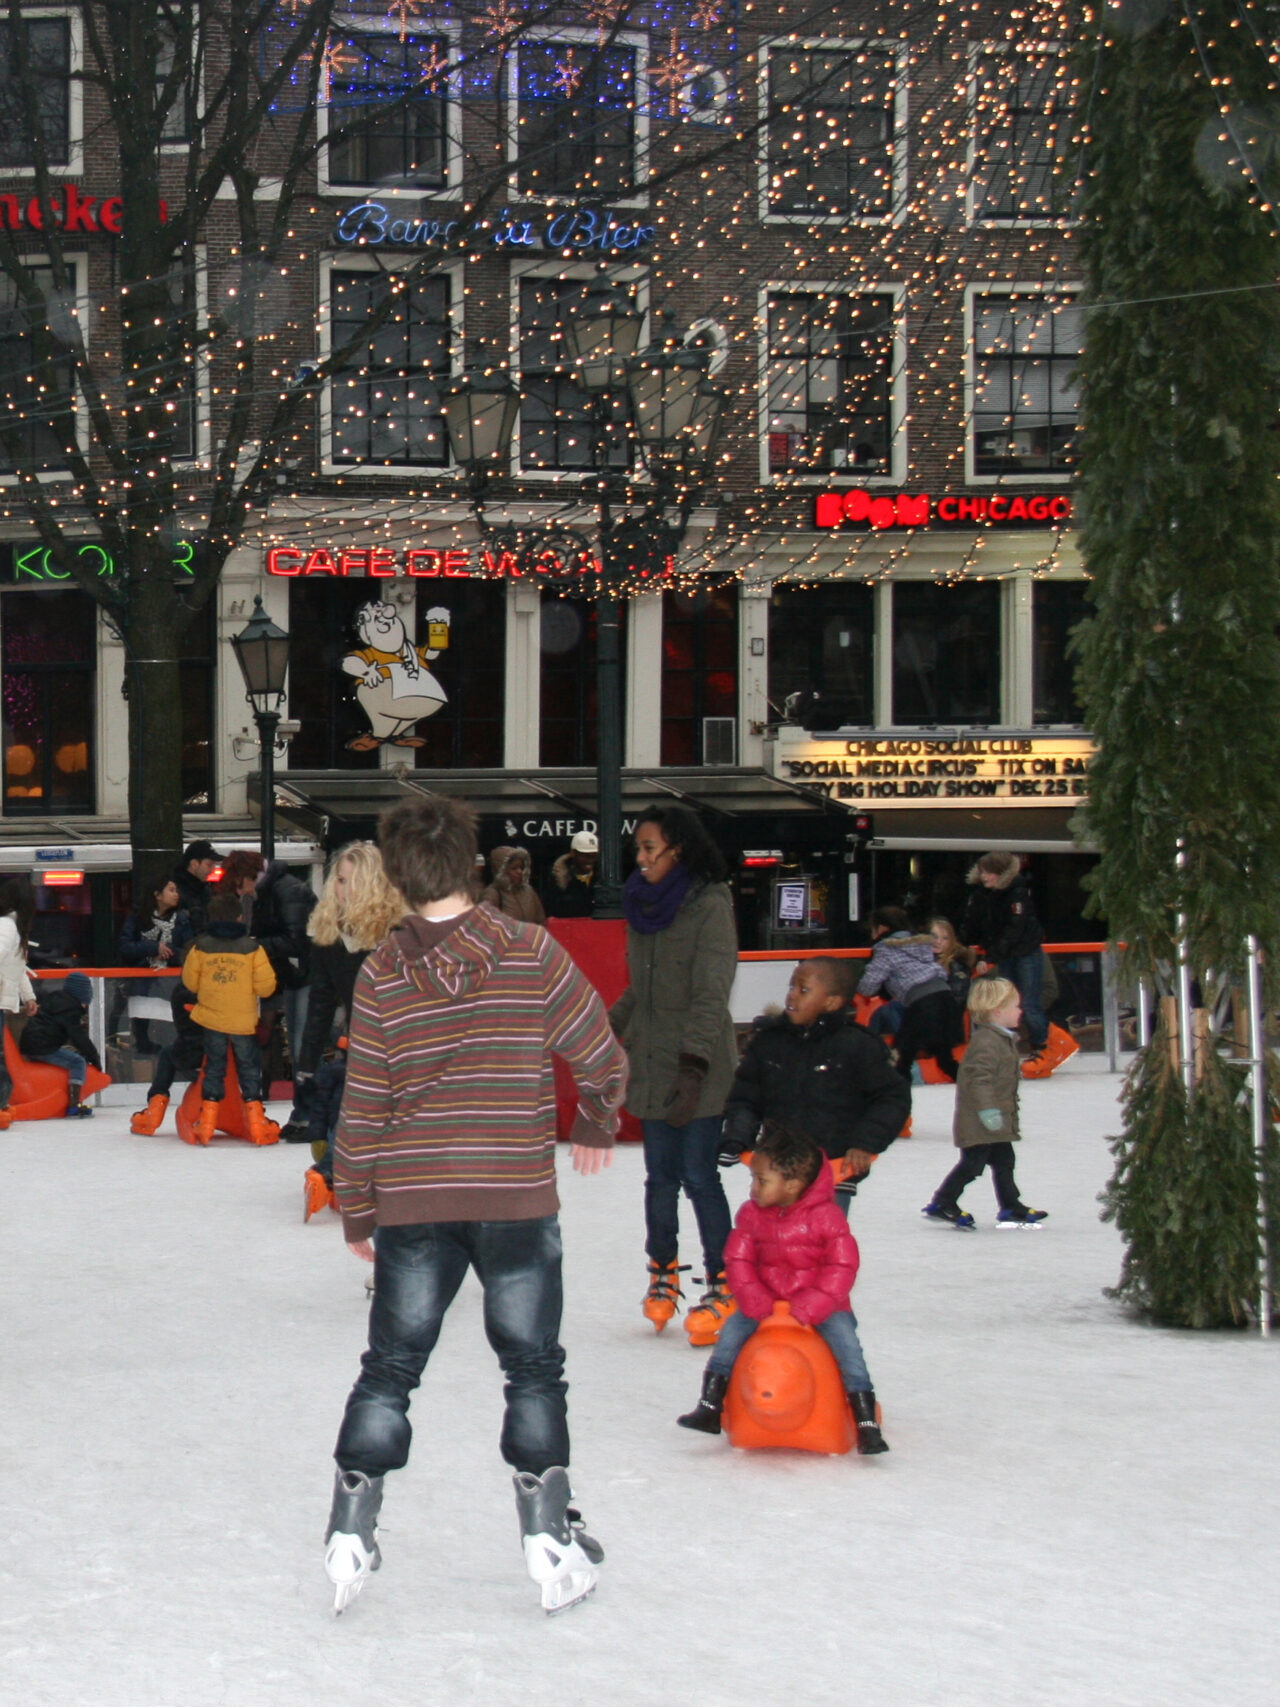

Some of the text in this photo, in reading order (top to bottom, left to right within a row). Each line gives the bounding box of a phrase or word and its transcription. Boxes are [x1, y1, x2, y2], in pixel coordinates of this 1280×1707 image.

[937, 496, 1072, 521] CHICAGO
[16, 542, 195, 580] KOOR
[268, 548, 396, 577] CAFE
[407, 549, 470, 577] DE
[846, 740, 1033, 756] CHICAGO SOCIAL CLUB
[998, 759, 1026, 776] TIX
[1031, 758, 1056, 775] ON
[837, 781, 865, 798] BIG
[868, 781, 942, 798] HOLIDAY
[1010, 779, 1042, 795] DEC
[1044, 779, 1069, 796] 25
[523, 820, 576, 837] CAFE
